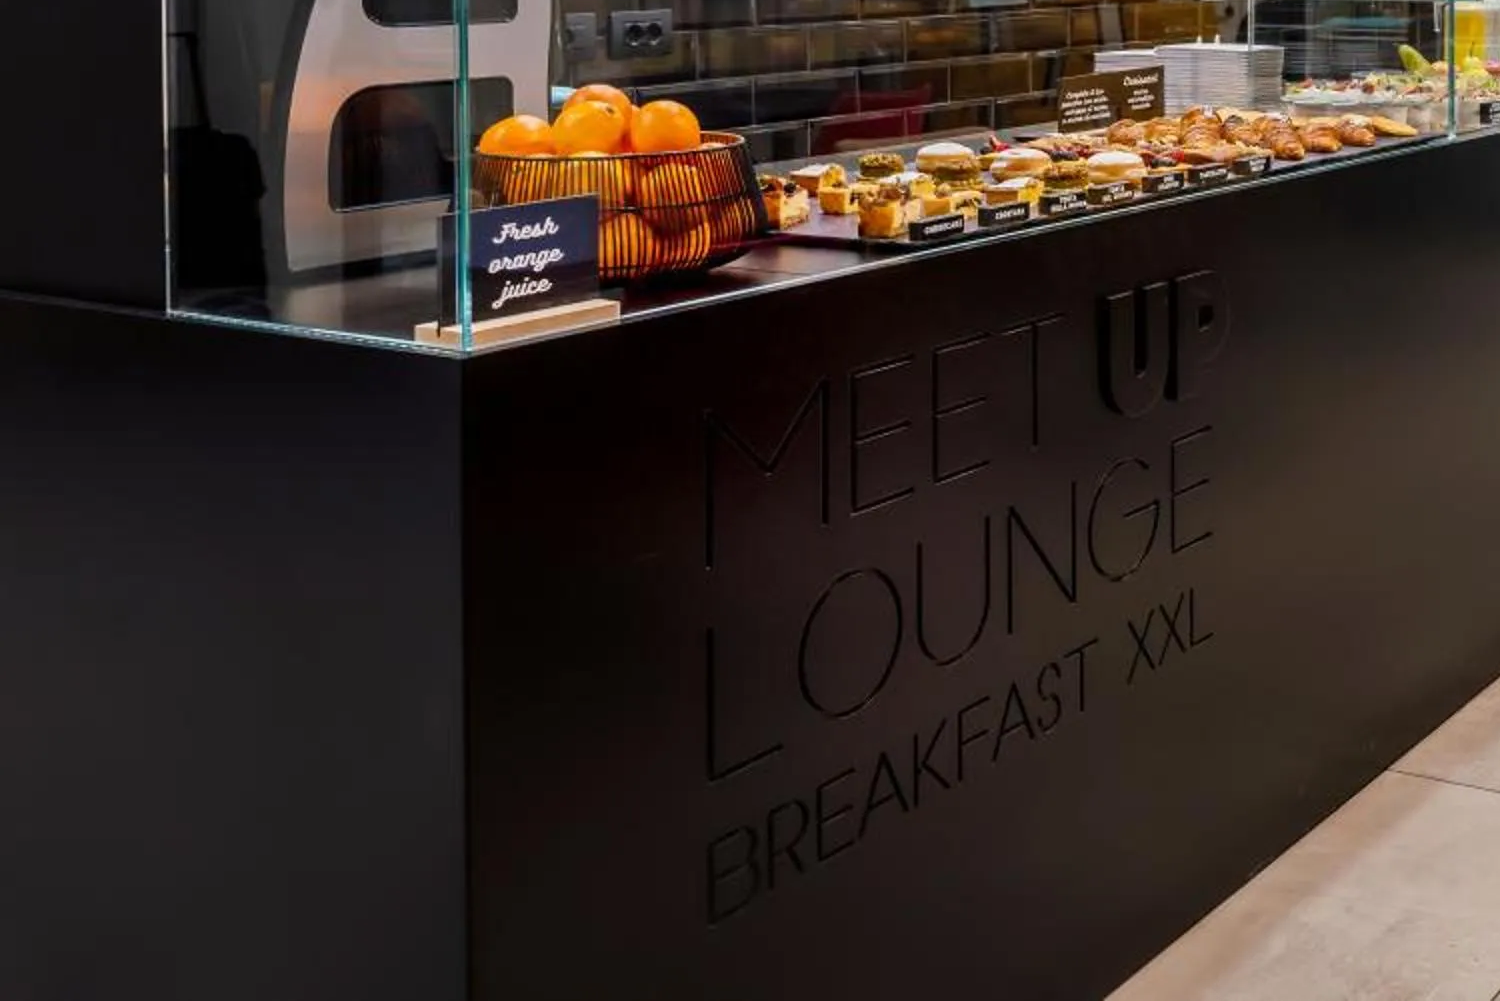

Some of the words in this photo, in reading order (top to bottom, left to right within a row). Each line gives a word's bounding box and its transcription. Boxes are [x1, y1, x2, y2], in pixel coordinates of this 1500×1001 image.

[488, 247, 564, 274] orange
[492, 216, 560, 244] Fresh
[492, 275, 552, 310] juice
[705, 312, 1067, 572] MEET
[1101, 270, 1231, 418] UP
[706, 425, 1213, 782] LOUNGE
[706, 637, 1098, 926] BREAKFAST
[1127, 587, 1214, 685] XXL
